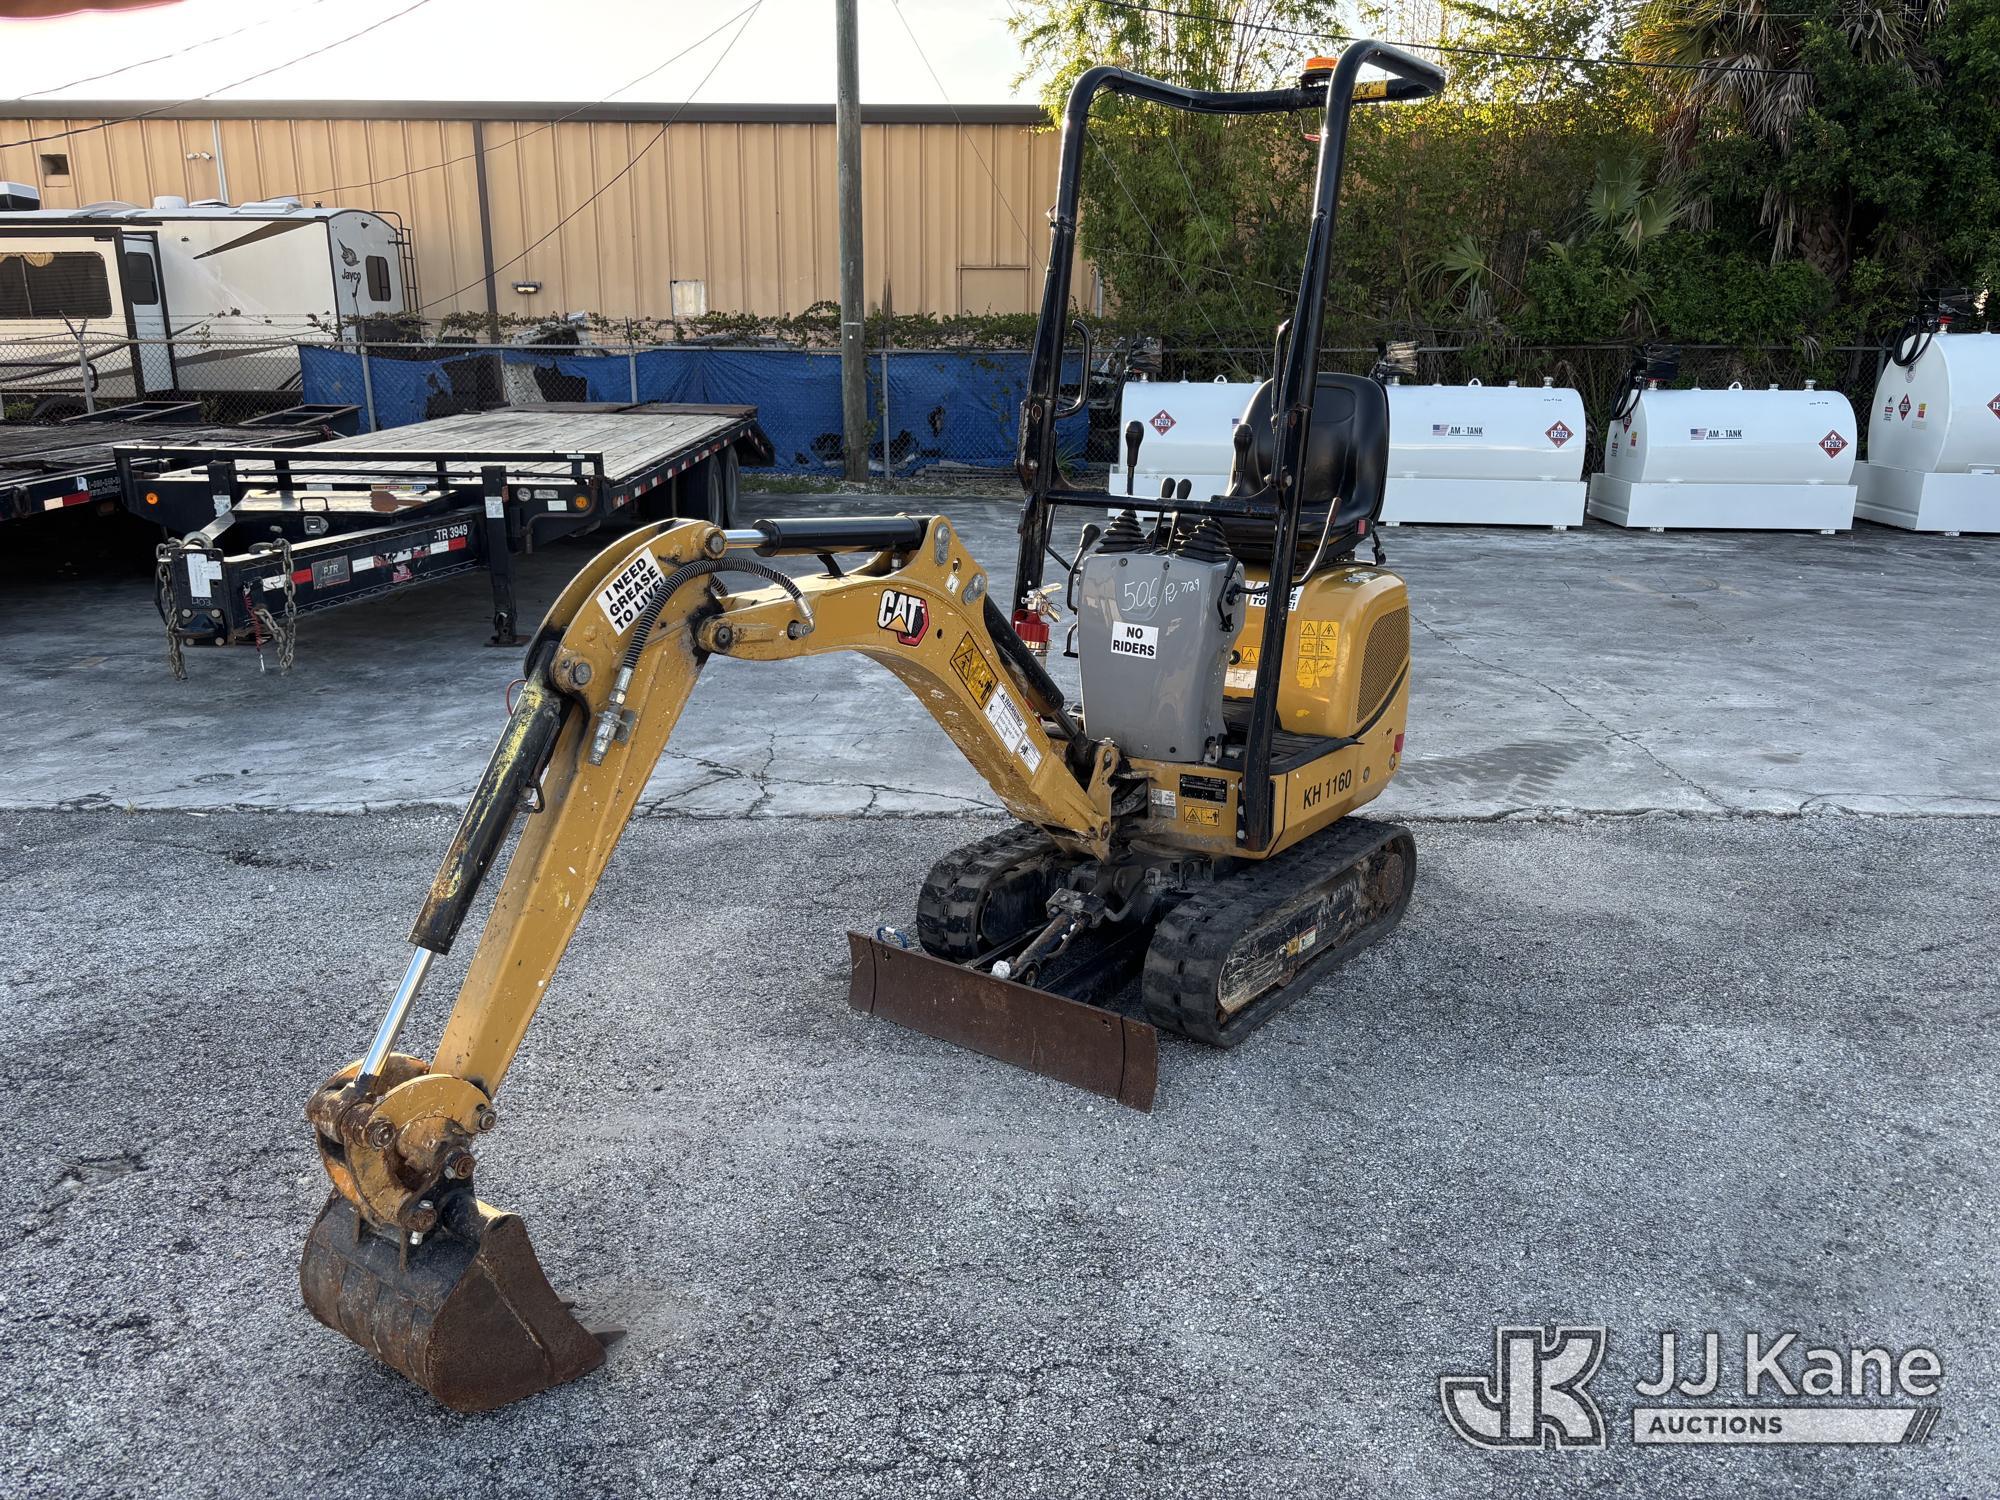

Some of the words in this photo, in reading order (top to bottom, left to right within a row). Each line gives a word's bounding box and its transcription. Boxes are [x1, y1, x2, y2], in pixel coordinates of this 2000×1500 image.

[342, 268, 361, 282] Jayco
[1450, 426, 1461, 435] AM
[1467, 426, 1483, 435] TANK
[1552, 430, 1567, 438] 1202
[1708, 429, 1719, 437] AM
[1725, 429, 1742, 437] TANK
[449, 525, 468, 538] 3949
[605, 590, 613, 601] I
[612, 558, 647, 594] NEED
[609, 565, 658, 616] GREASE
[1121, 577, 1158, 611] 506
[1252, 597, 1267, 606] TO
[614, 609, 634, 630] TO
[878, 590, 924, 634] CAT
[1126, 626, 1144, 640] NO
[1112, 639, 1155, 656] RIDERS
[1303, 782, 1322, 810] KH
[1325, 769, 1352, 798] 1160
